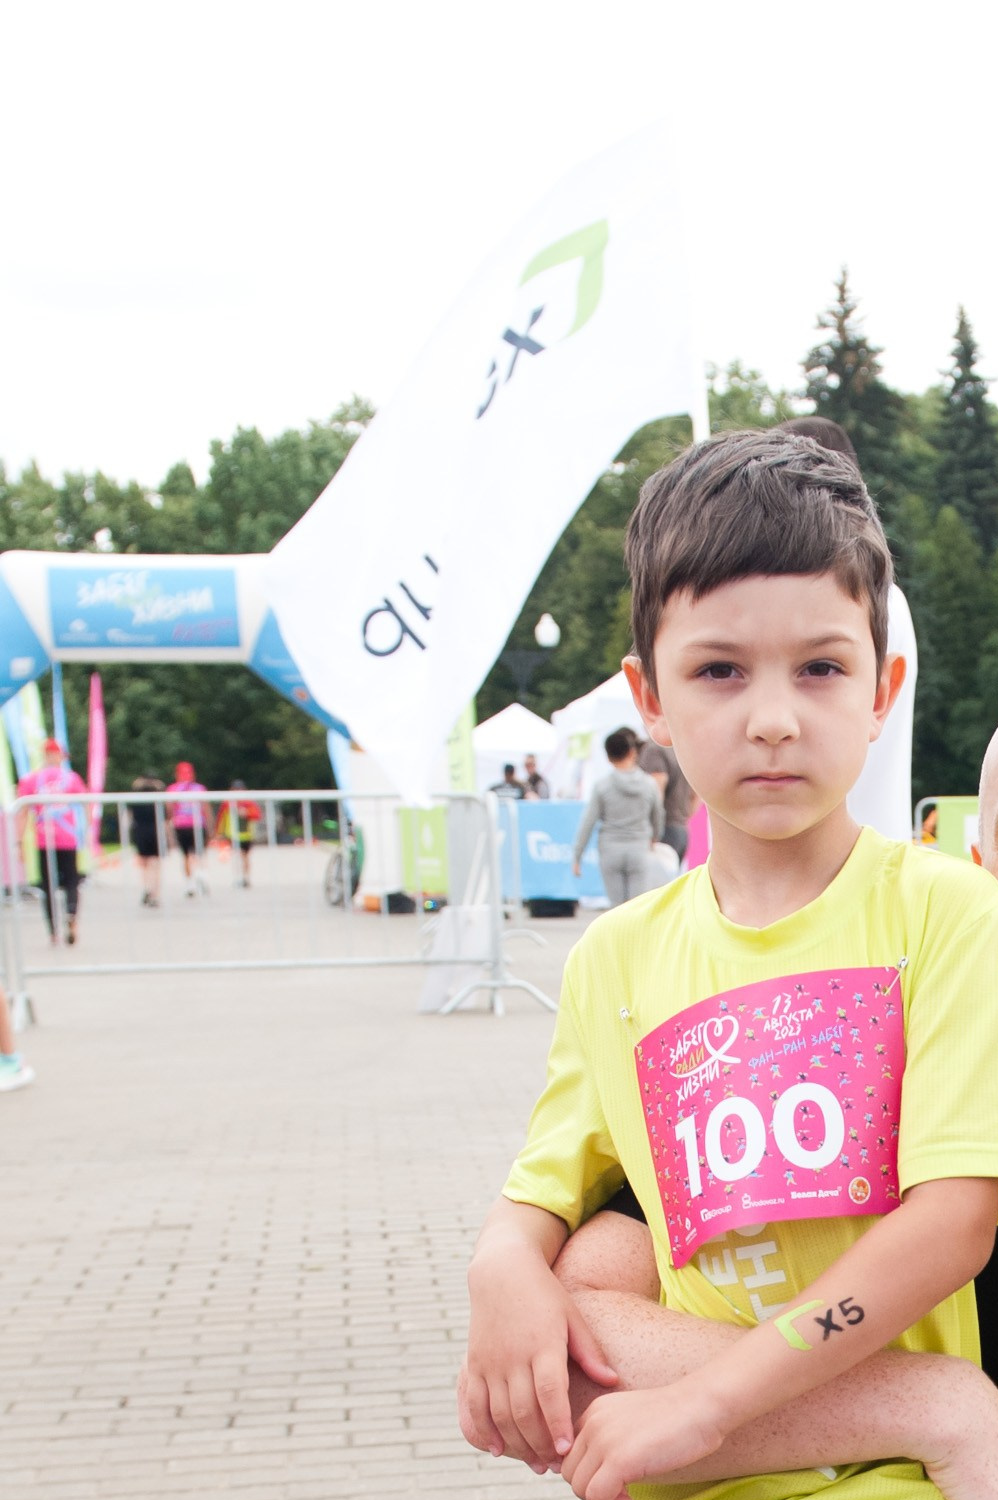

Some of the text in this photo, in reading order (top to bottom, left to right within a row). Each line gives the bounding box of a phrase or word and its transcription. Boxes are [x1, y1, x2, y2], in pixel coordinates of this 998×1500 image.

[772, 992, 792, 1015] 13
[763, 1007, 814, 1033] АВГУСТА
[774, 1022, 802, 1041] 2023
[811, 1024, 845, 1046] ЗАБЕГ
[669, 1021, 706, 1067] ЗАБЕГ
[675, 1045, 705, 1076] РАДИ
[675, 1059, 721, 1107] ЖИЗНИ
[675, 1082, 845, 1199] 100
[813, 1296, 866, 1342] X5
